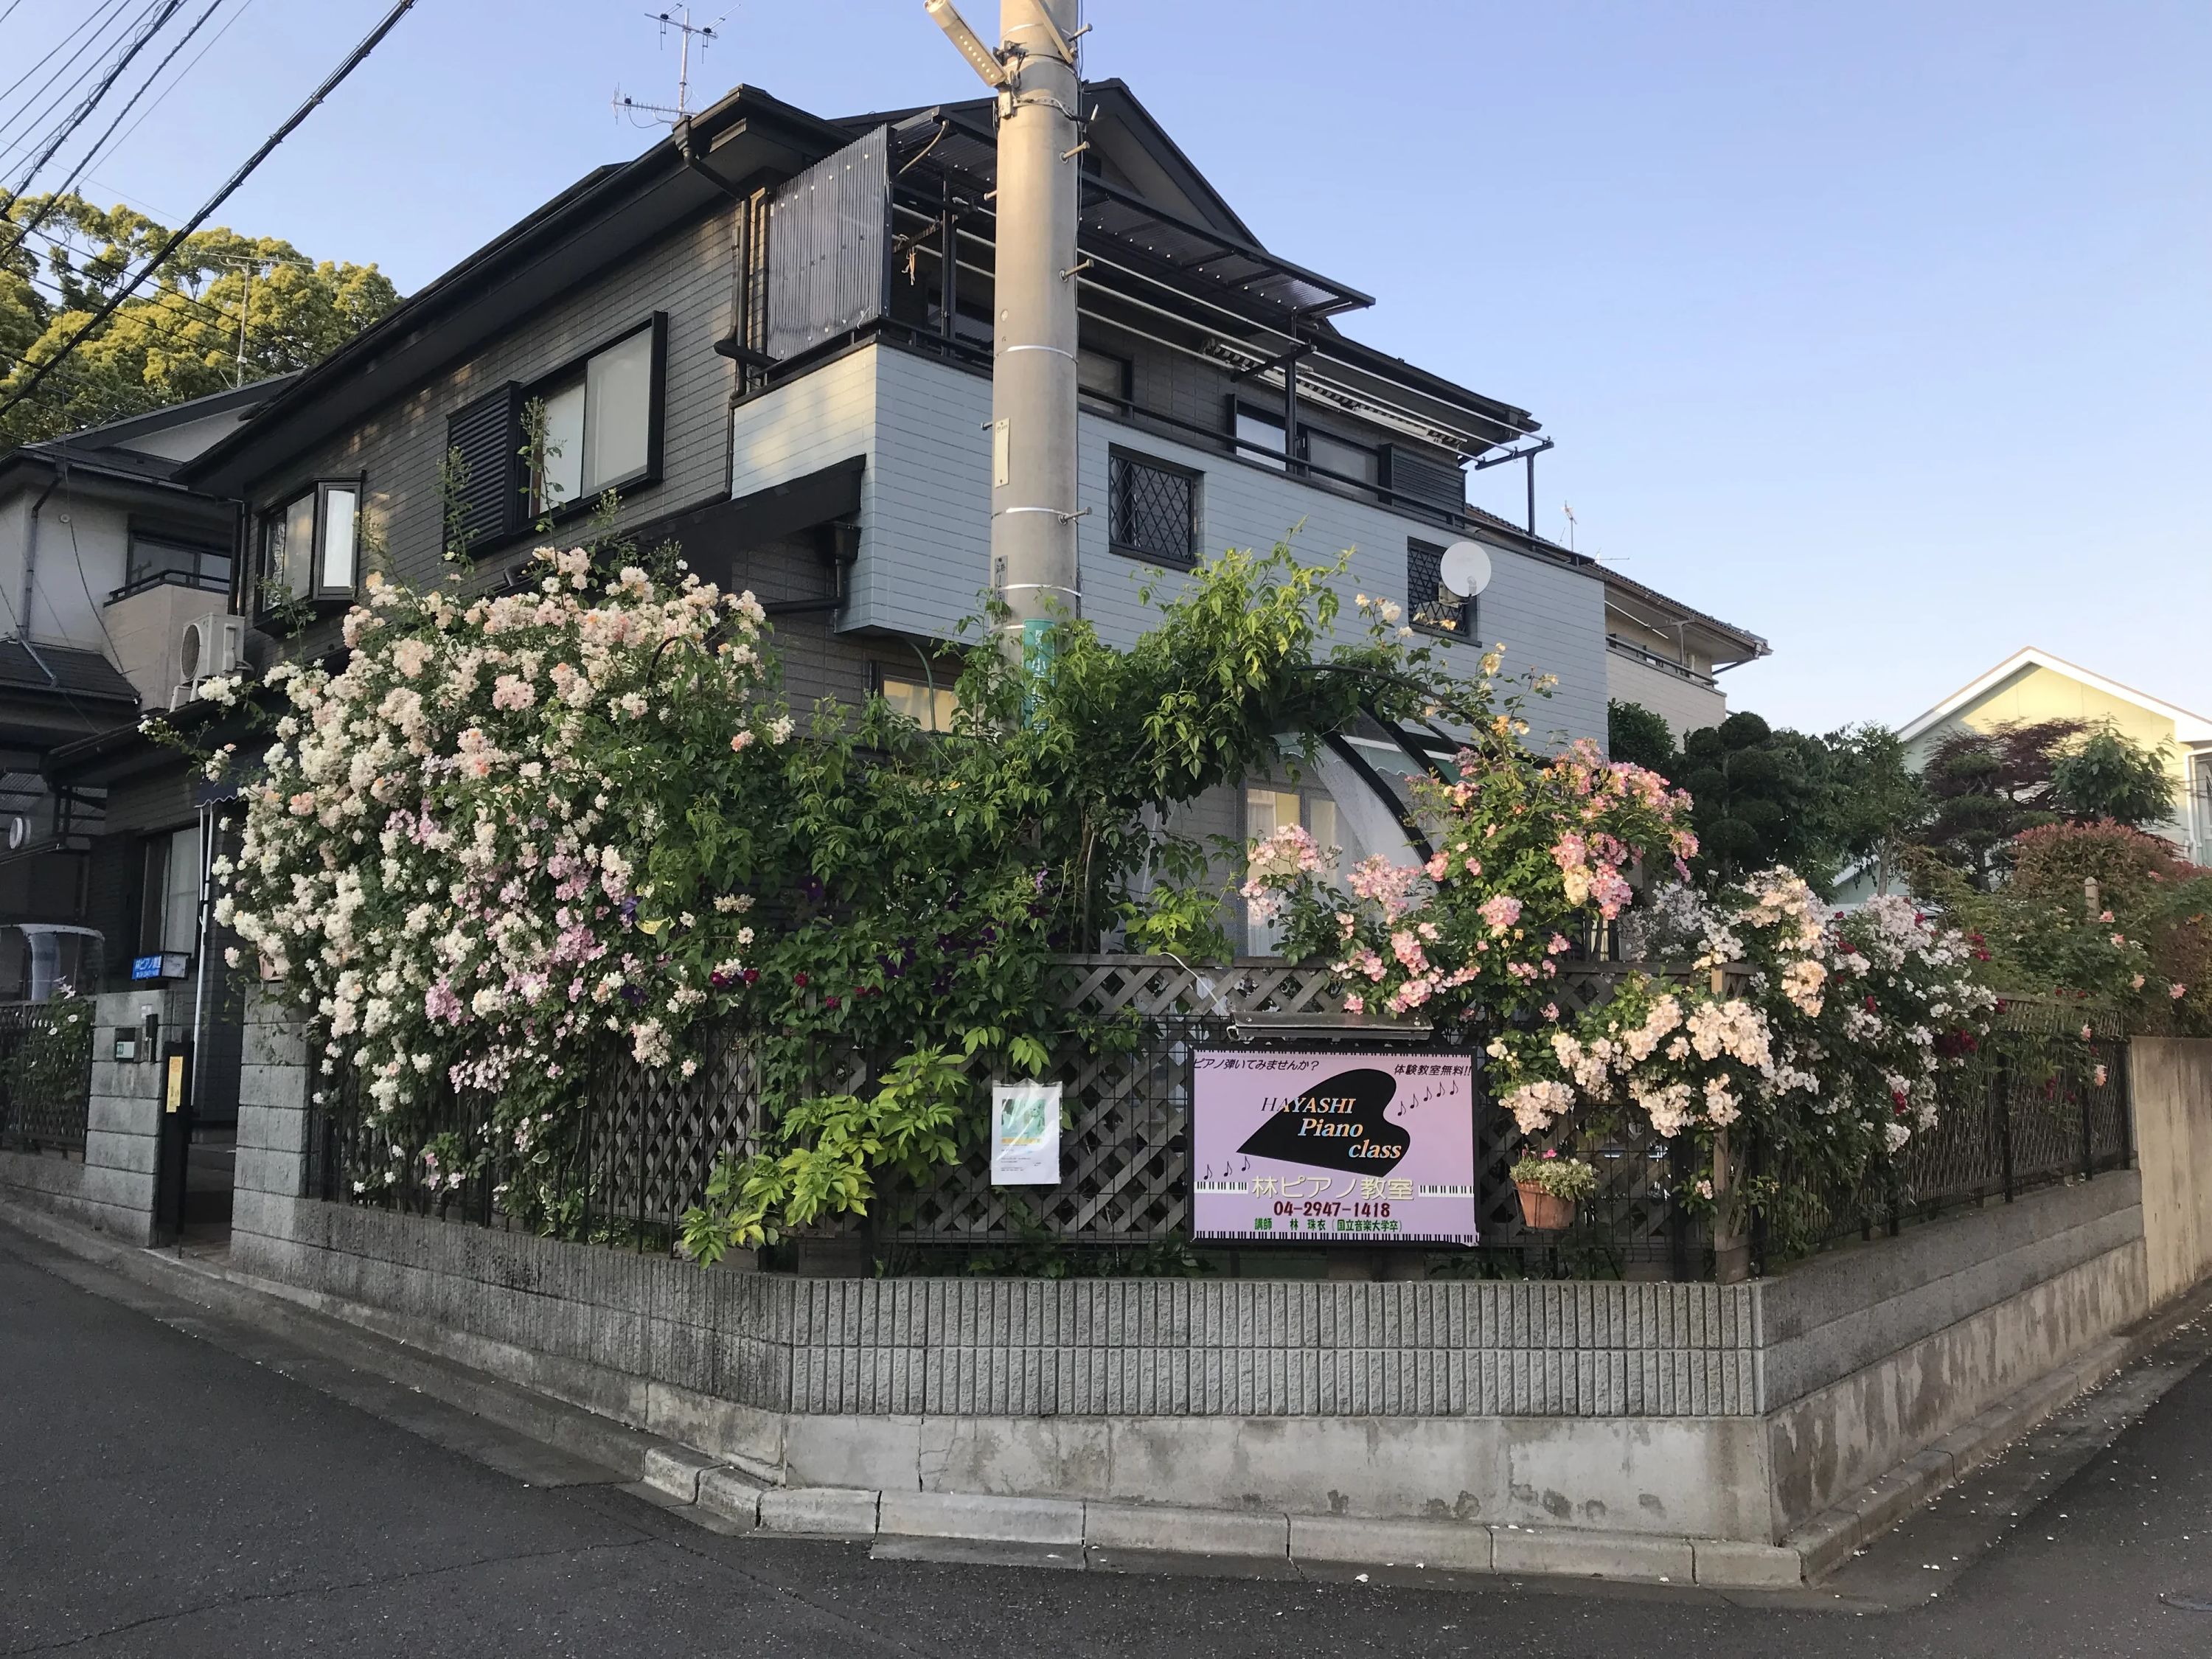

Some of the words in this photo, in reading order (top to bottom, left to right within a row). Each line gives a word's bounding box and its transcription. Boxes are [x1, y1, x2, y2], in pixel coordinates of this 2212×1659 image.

[1261, 1097, 1356, 1113] HAYASHI
[1297, 1118, 1363, 1137] Piano
[1349, 1139, 1402, 1158] class
[1251, 1176, 1413, 1200] 林ピアノ教室
[1273, 1201, 1391, 1217] 04-2947-1418
[1290, 1219, 1298, 1230] 林
